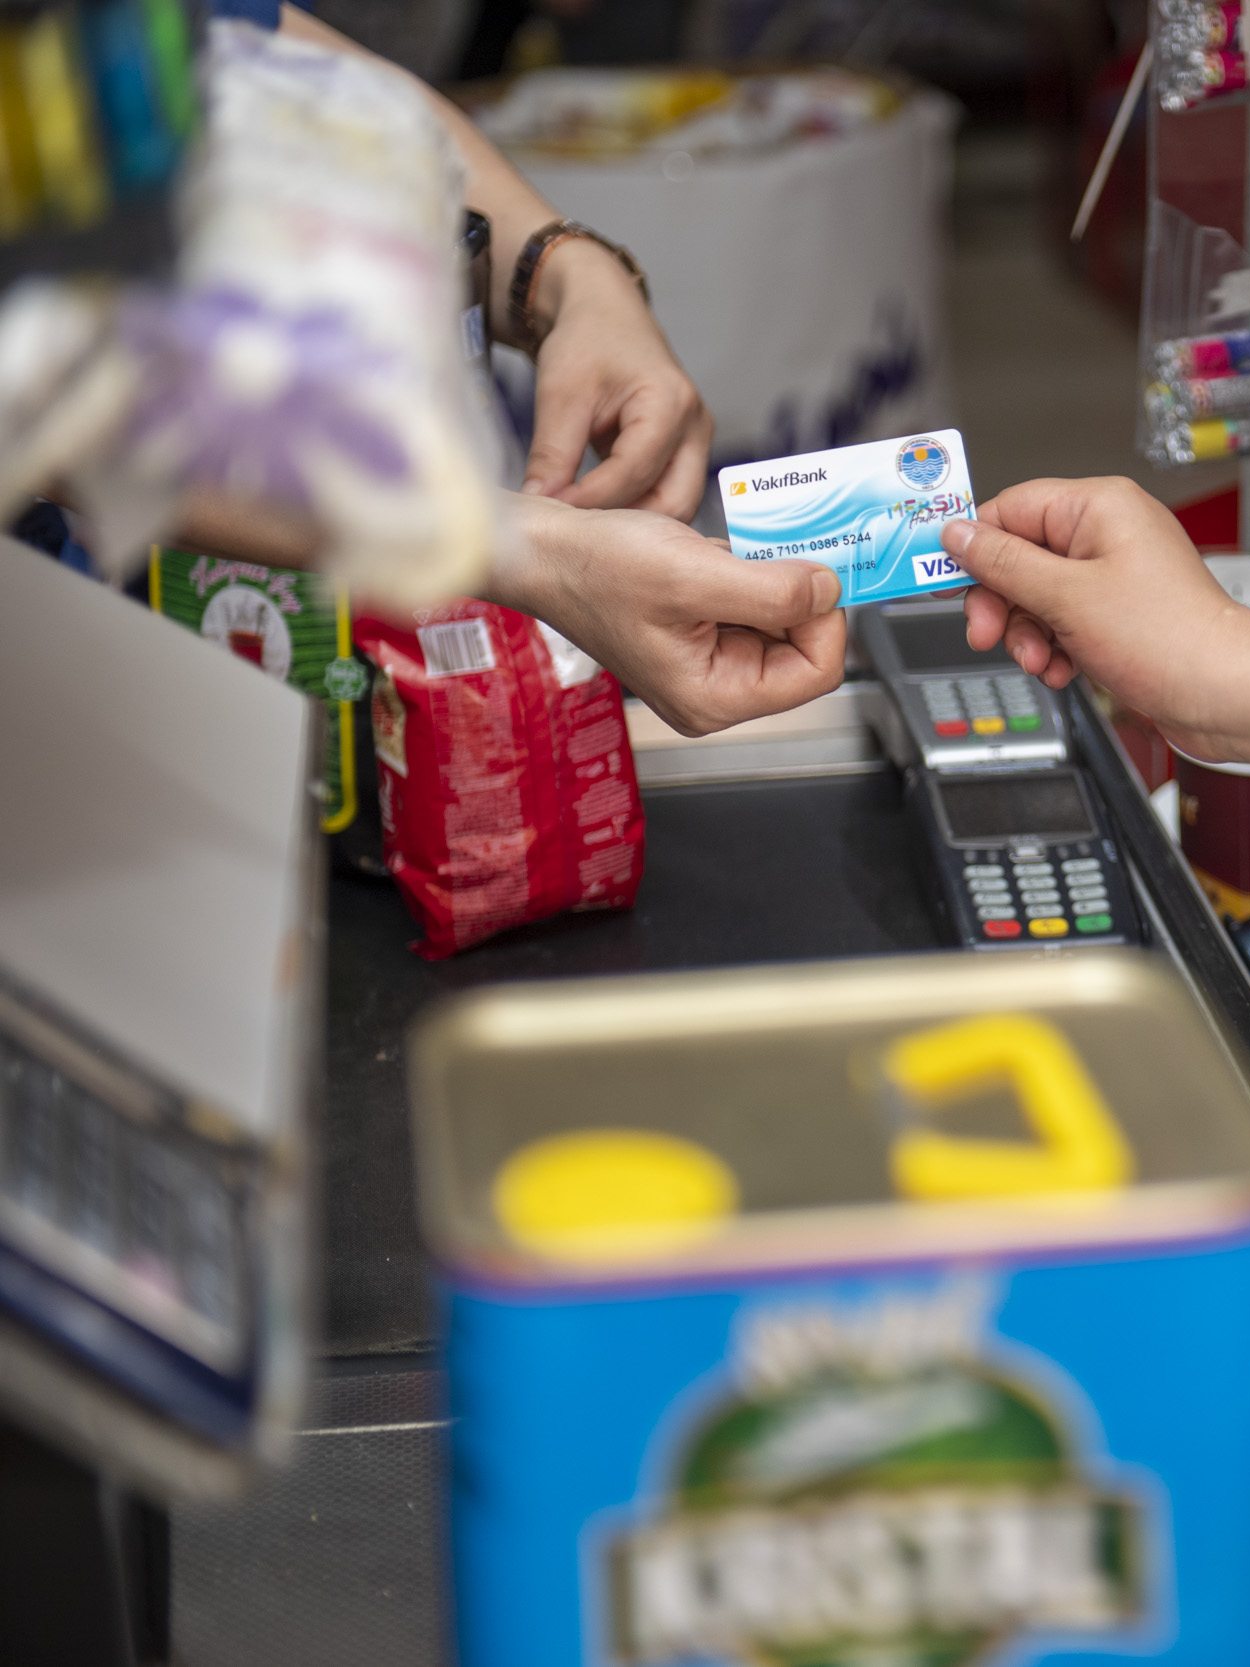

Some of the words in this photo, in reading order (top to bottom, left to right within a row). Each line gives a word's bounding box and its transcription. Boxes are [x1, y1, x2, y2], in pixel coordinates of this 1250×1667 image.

[751, 467, 827, 491] VakıfBank
[745, 548, 774, 560] 4426
[777, 542, 806, 556] 7101
[809, 537, 839, 551] 0386
[842, 532, 871, 546] 5244
[851, 560, 876, 572] 10/26
